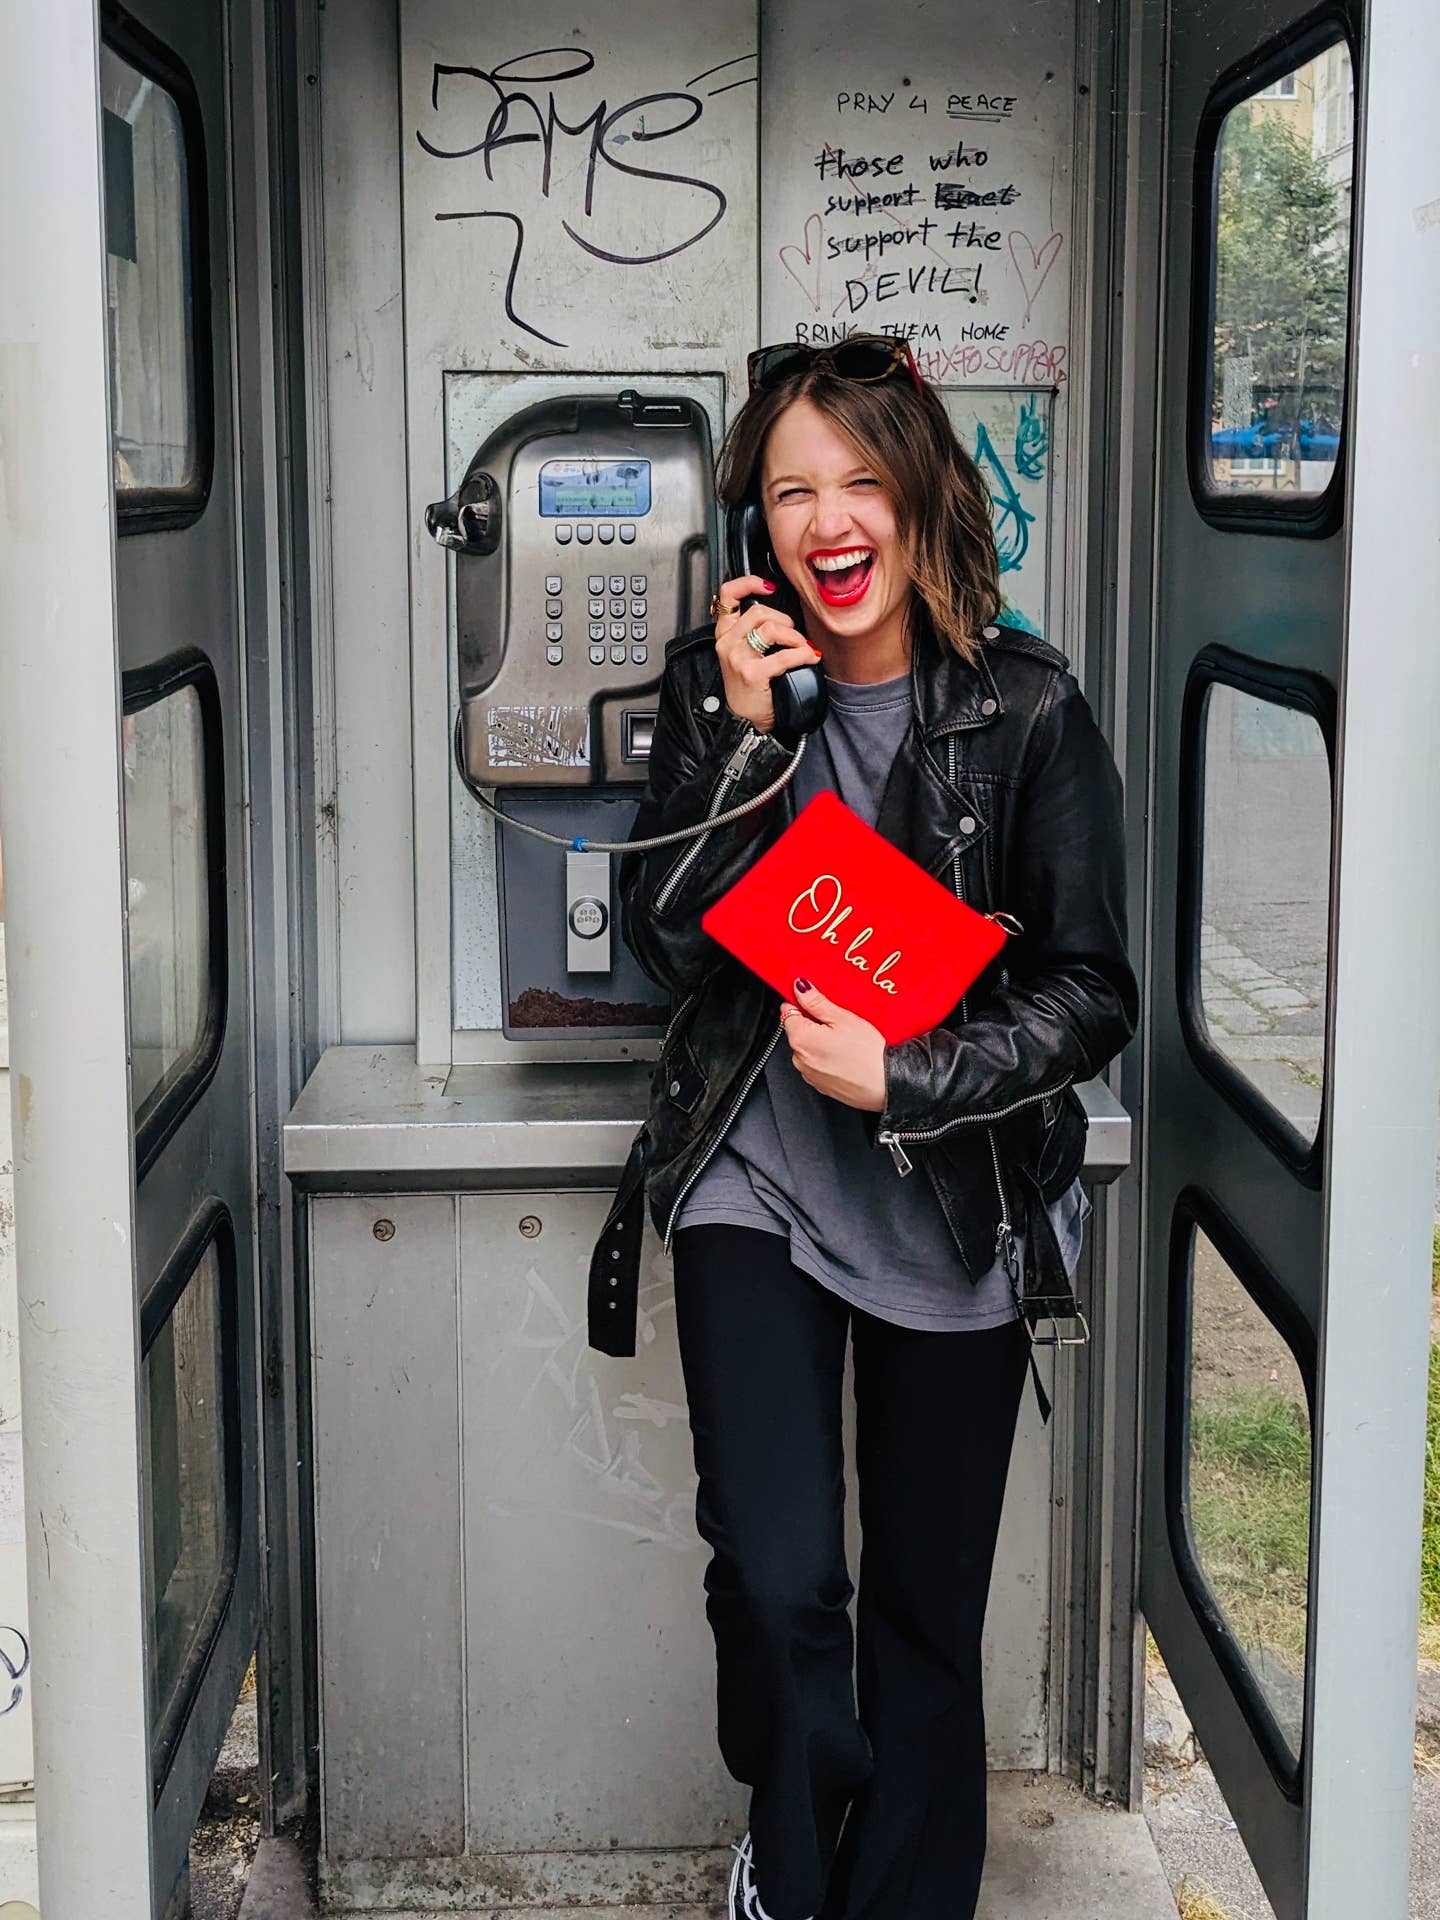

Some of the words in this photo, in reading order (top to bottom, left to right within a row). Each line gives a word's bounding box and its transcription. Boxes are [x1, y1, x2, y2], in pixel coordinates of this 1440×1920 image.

[837, 92, 895, 113] PRAY
[908, 95, 928, 114] 4
[946, 93, 1018, 112] PEACE
[814, 148, 904, 180] those
[929, 141, 988, 170] who
[824, 183, 920, 216] support
[827, 217, 938, 261] support
[947, 221, 1002, 251] the
[845, 263, 983, 313] DEVIL!
[880, 322, 942, 342] THEM
[961, 322, 1010, 341] HOME
[788, 875, 853, 945] Oh
[845, 927, 874, 971] la
[872, 950, 902, 995] la
